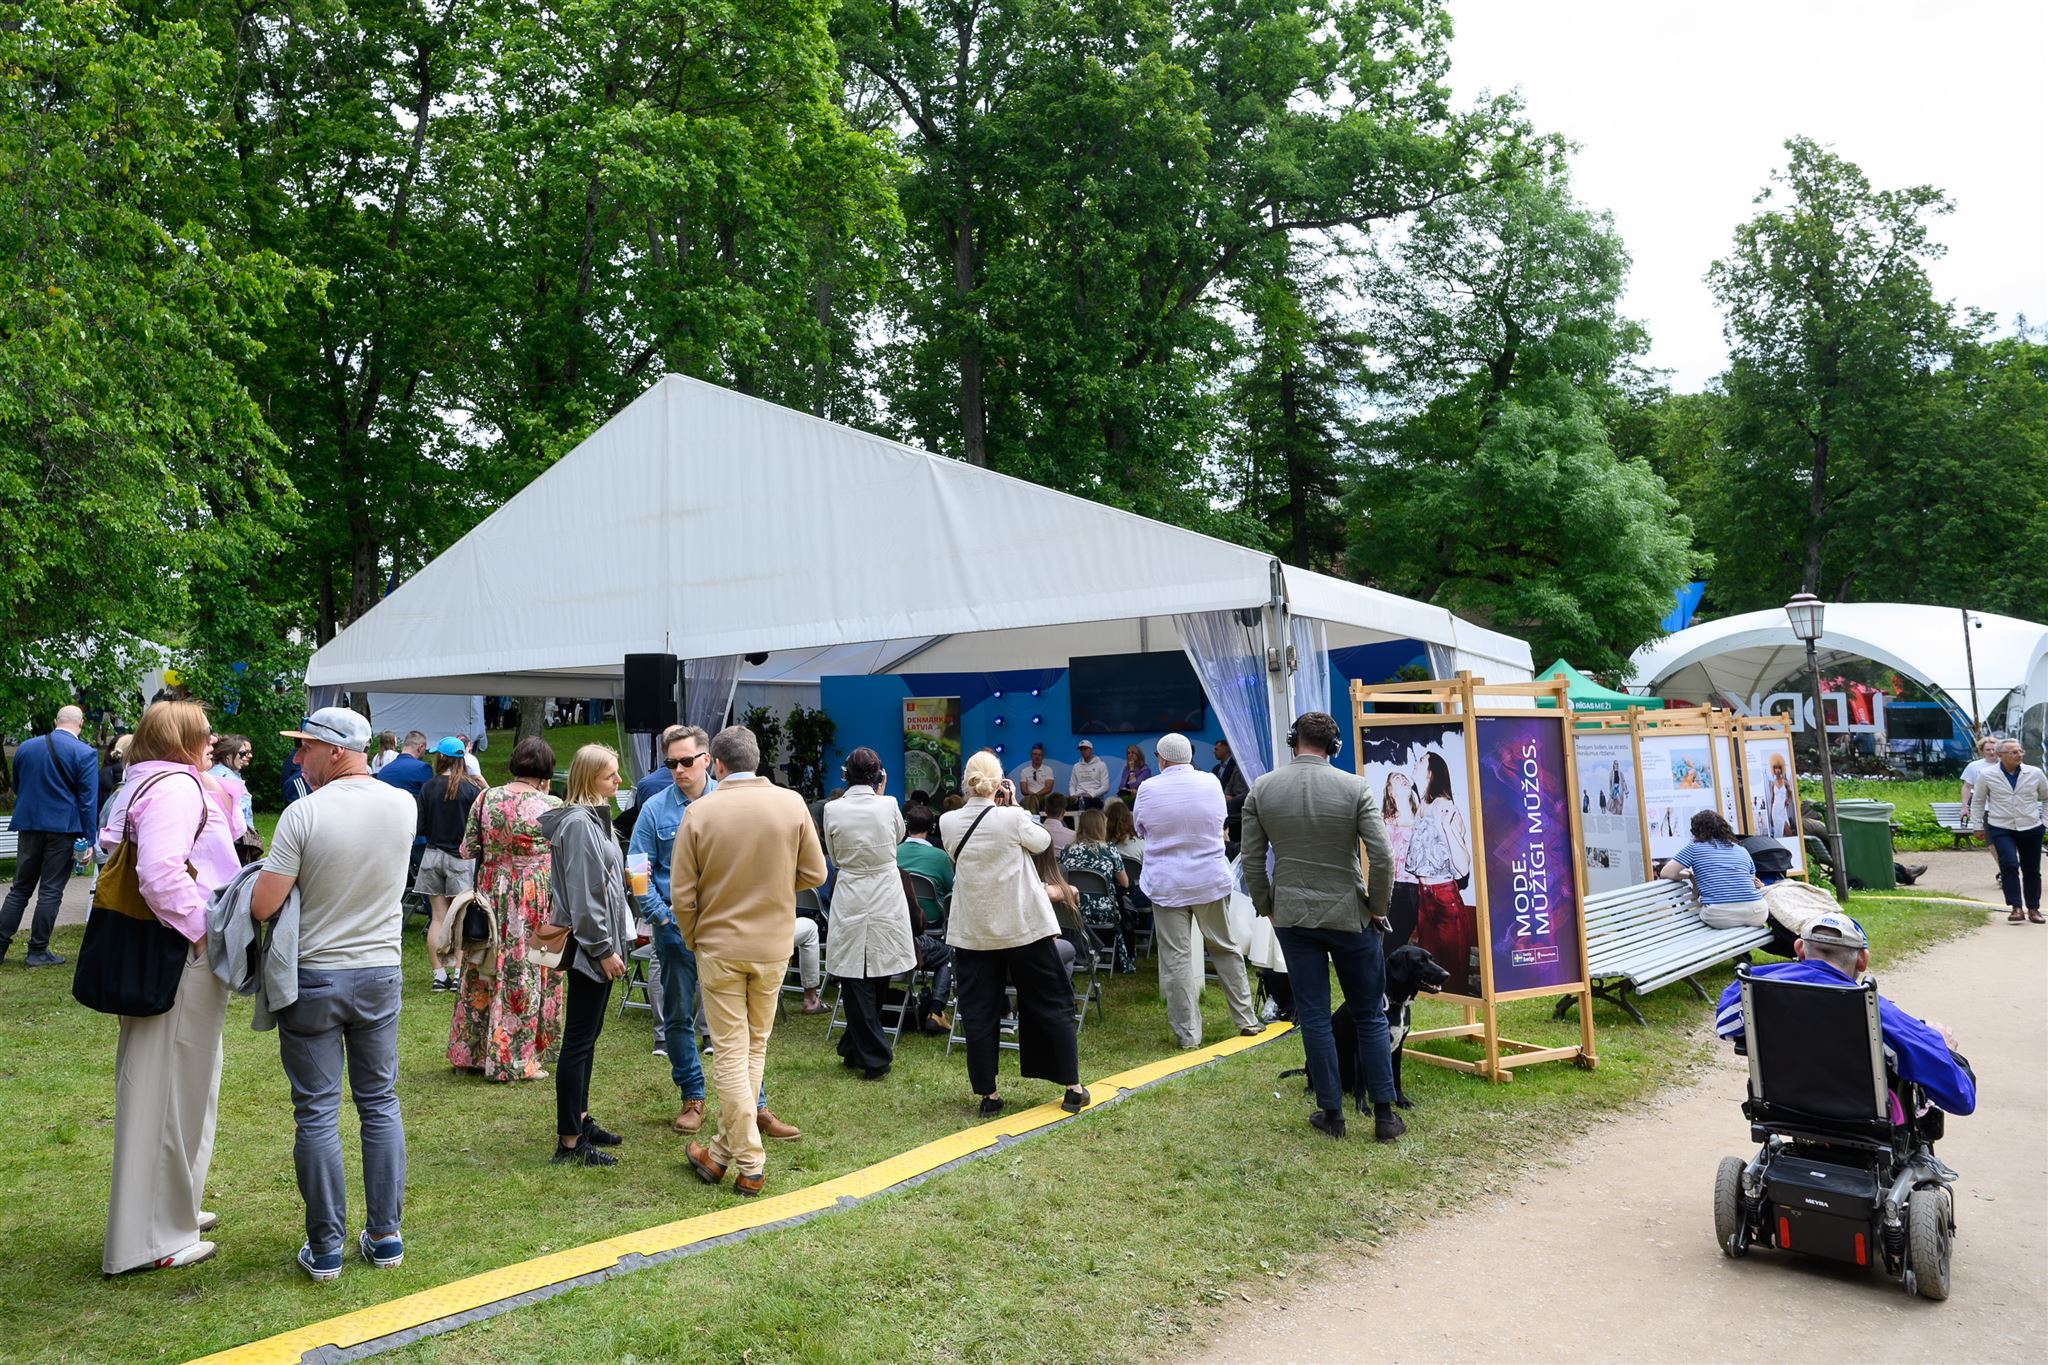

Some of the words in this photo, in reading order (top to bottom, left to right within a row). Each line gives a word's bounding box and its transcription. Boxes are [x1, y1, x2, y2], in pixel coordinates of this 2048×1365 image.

[1520, 738, 1543, 834] MŪŽOS.
[1512, 852, 1532, 937] MODE.
[1528, 841, 1550, 935] MŪŽĪGI
[1805, 1198, 1829, 1207] MEYRA
